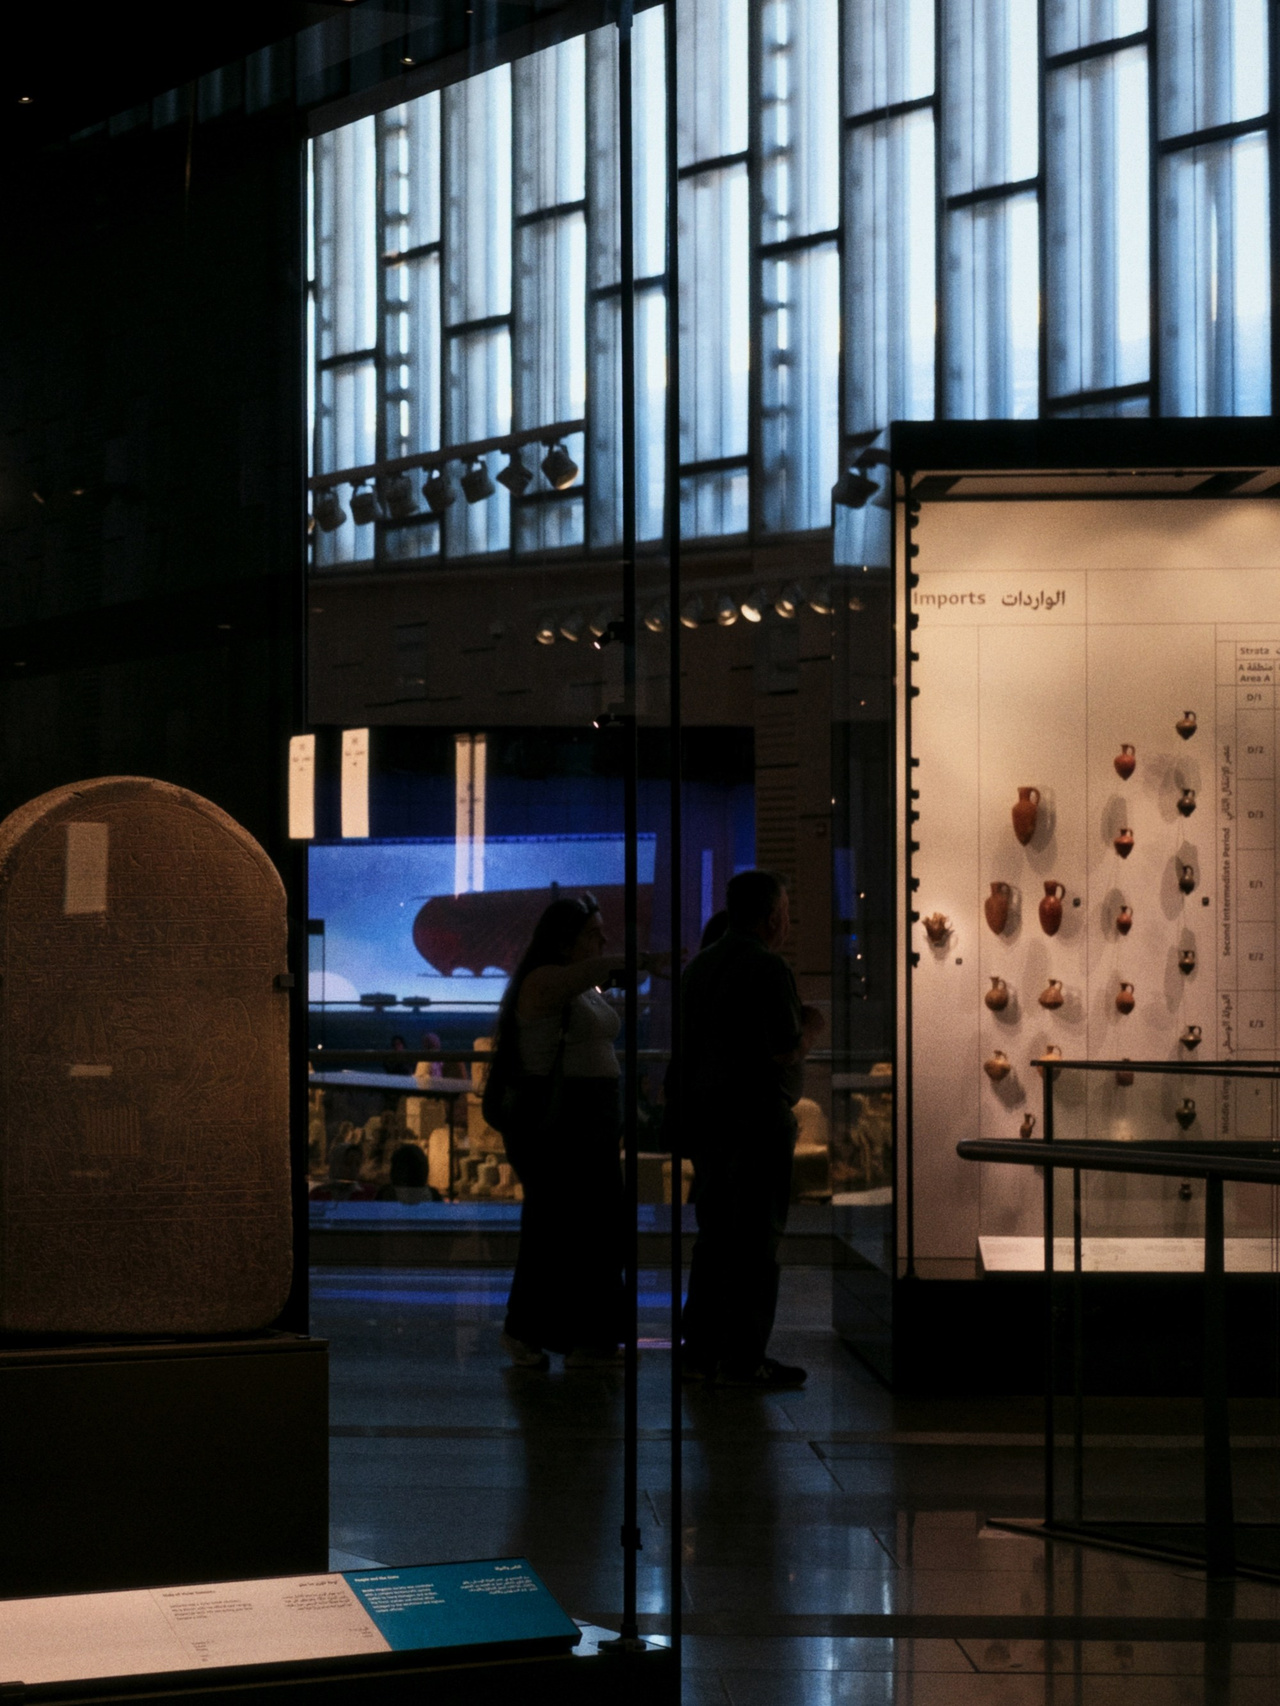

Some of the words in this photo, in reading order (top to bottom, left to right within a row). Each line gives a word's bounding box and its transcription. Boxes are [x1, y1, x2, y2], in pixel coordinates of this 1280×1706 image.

[913, 591, 986, 609] Imports
[1001, 590, 1066, 610] الواردات
[1240, 646, 1270, 655] Strata
[1240, 674, 1262, 683] Area
[1222, 827, 1230, 858] Period
[1222, 860, 1231, 921] Intermediate
[1222, 922, 1231, 957] Second
